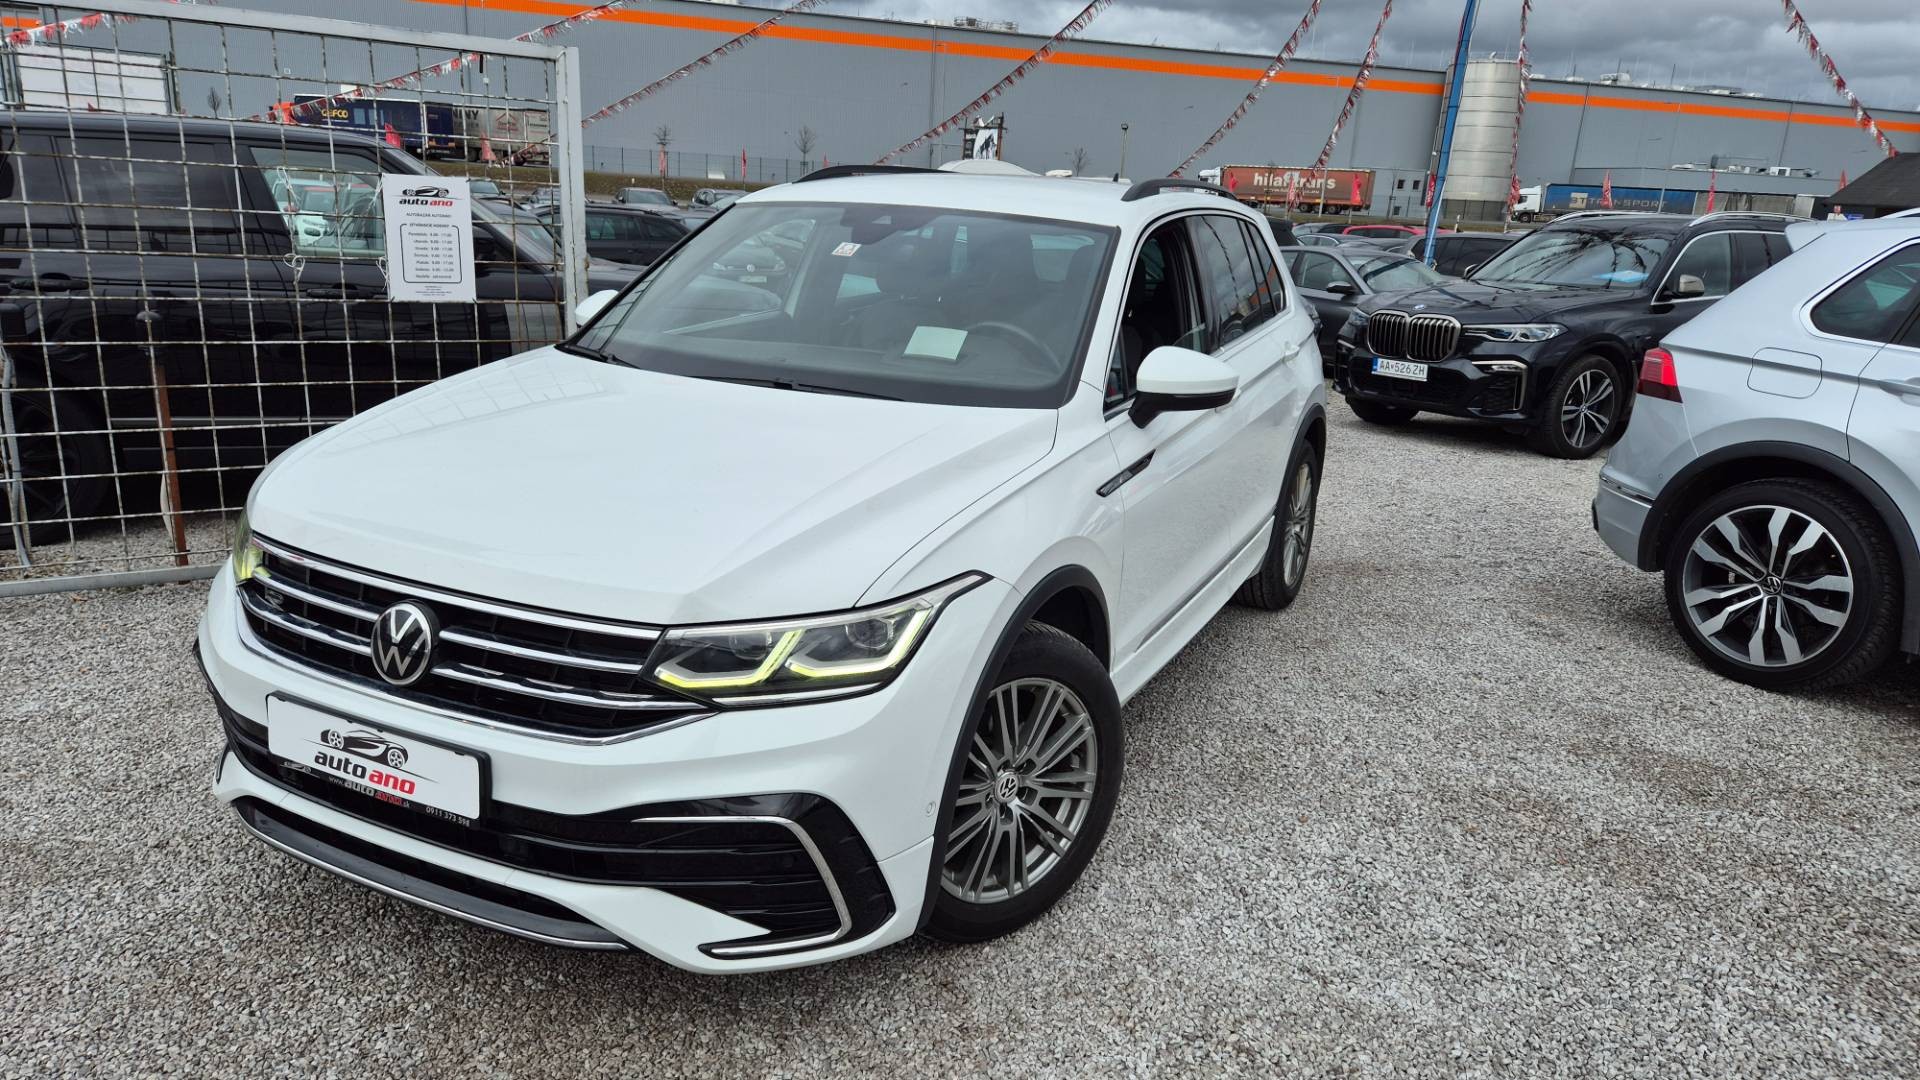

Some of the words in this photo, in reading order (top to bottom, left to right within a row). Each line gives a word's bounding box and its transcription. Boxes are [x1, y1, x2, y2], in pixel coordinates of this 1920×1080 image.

[321, 108, 349, 119] GEFCO
[399, 198, 428, 206] auto
[430, 199, 453, 207] ano
[314, 751, 367, 779] auto
[368, 769, 416, 795] ano
[425, 806, 442, 817] 0911
